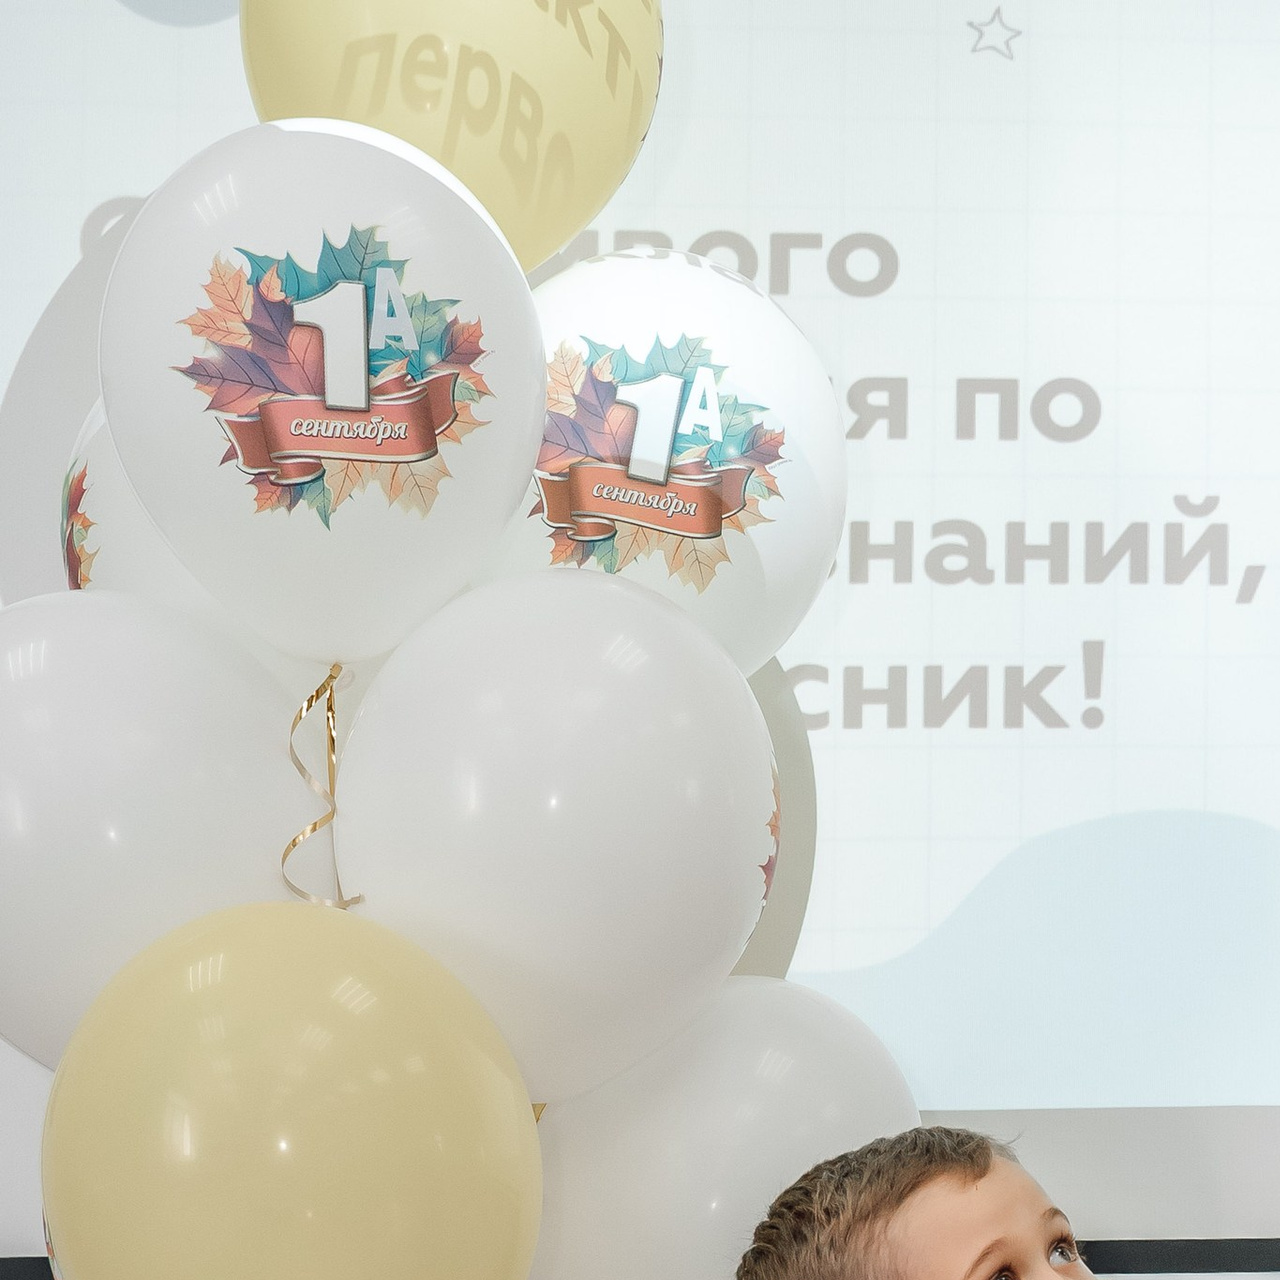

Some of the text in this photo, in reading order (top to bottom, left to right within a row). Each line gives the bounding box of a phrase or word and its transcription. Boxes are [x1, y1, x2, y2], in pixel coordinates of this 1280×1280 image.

[290, 415, 408, 446] сентября
[956, 377, 1102, 442] по
[592, 482, 698, 518] сентября
[830, 495, 1267, 604] наний,
